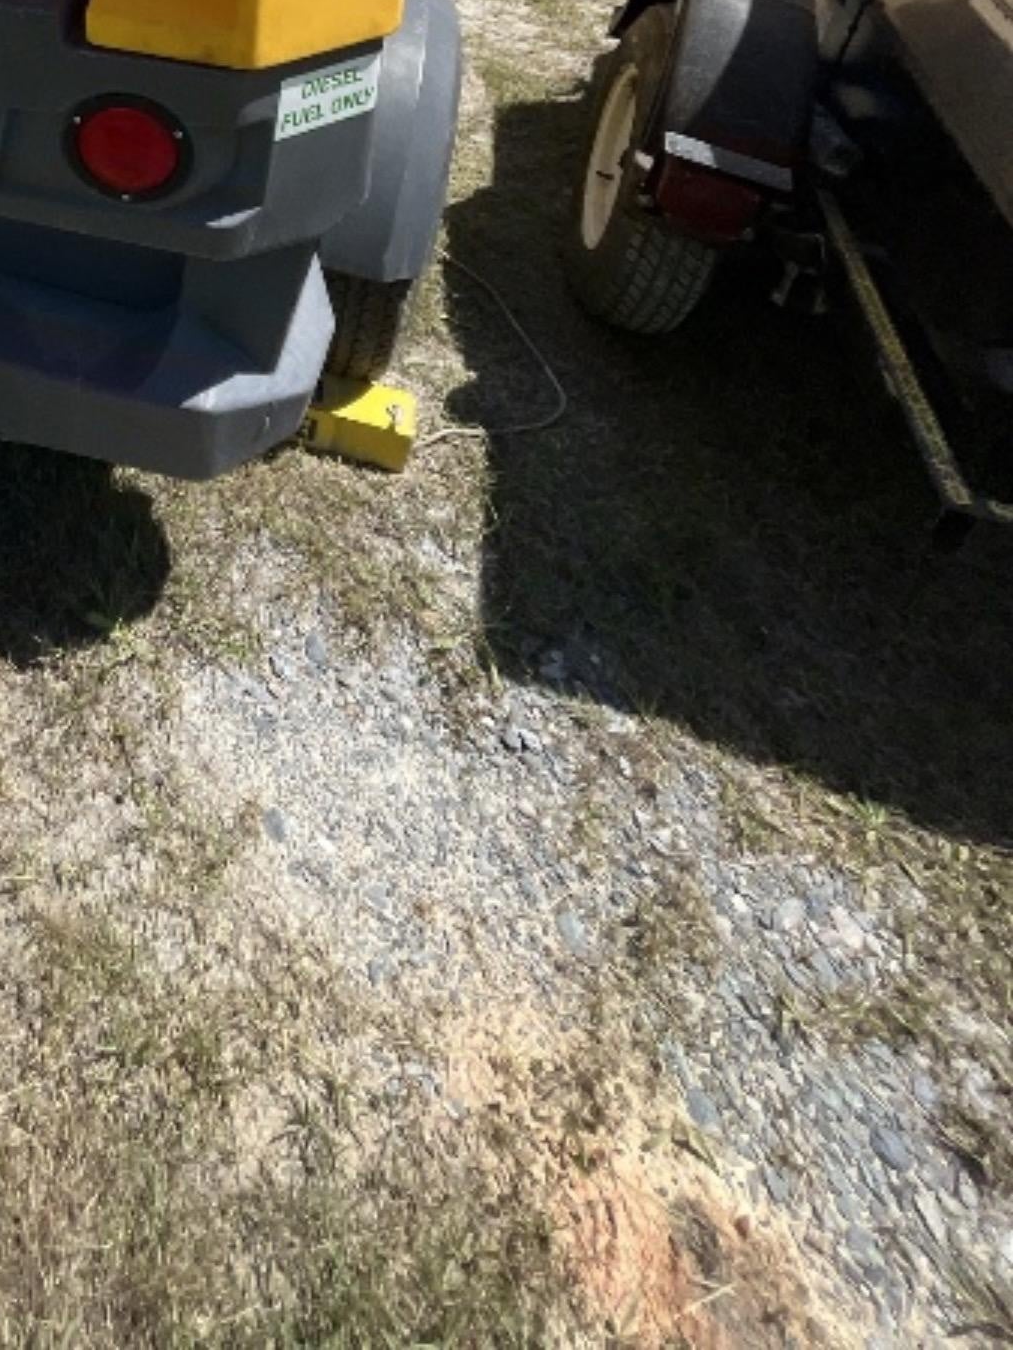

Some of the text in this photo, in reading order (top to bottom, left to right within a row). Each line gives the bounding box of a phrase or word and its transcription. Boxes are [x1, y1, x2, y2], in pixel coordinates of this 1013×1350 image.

[301, 69, 363, 100] DIESEL
[280, 86, 375, 132] FUEL ONLY
